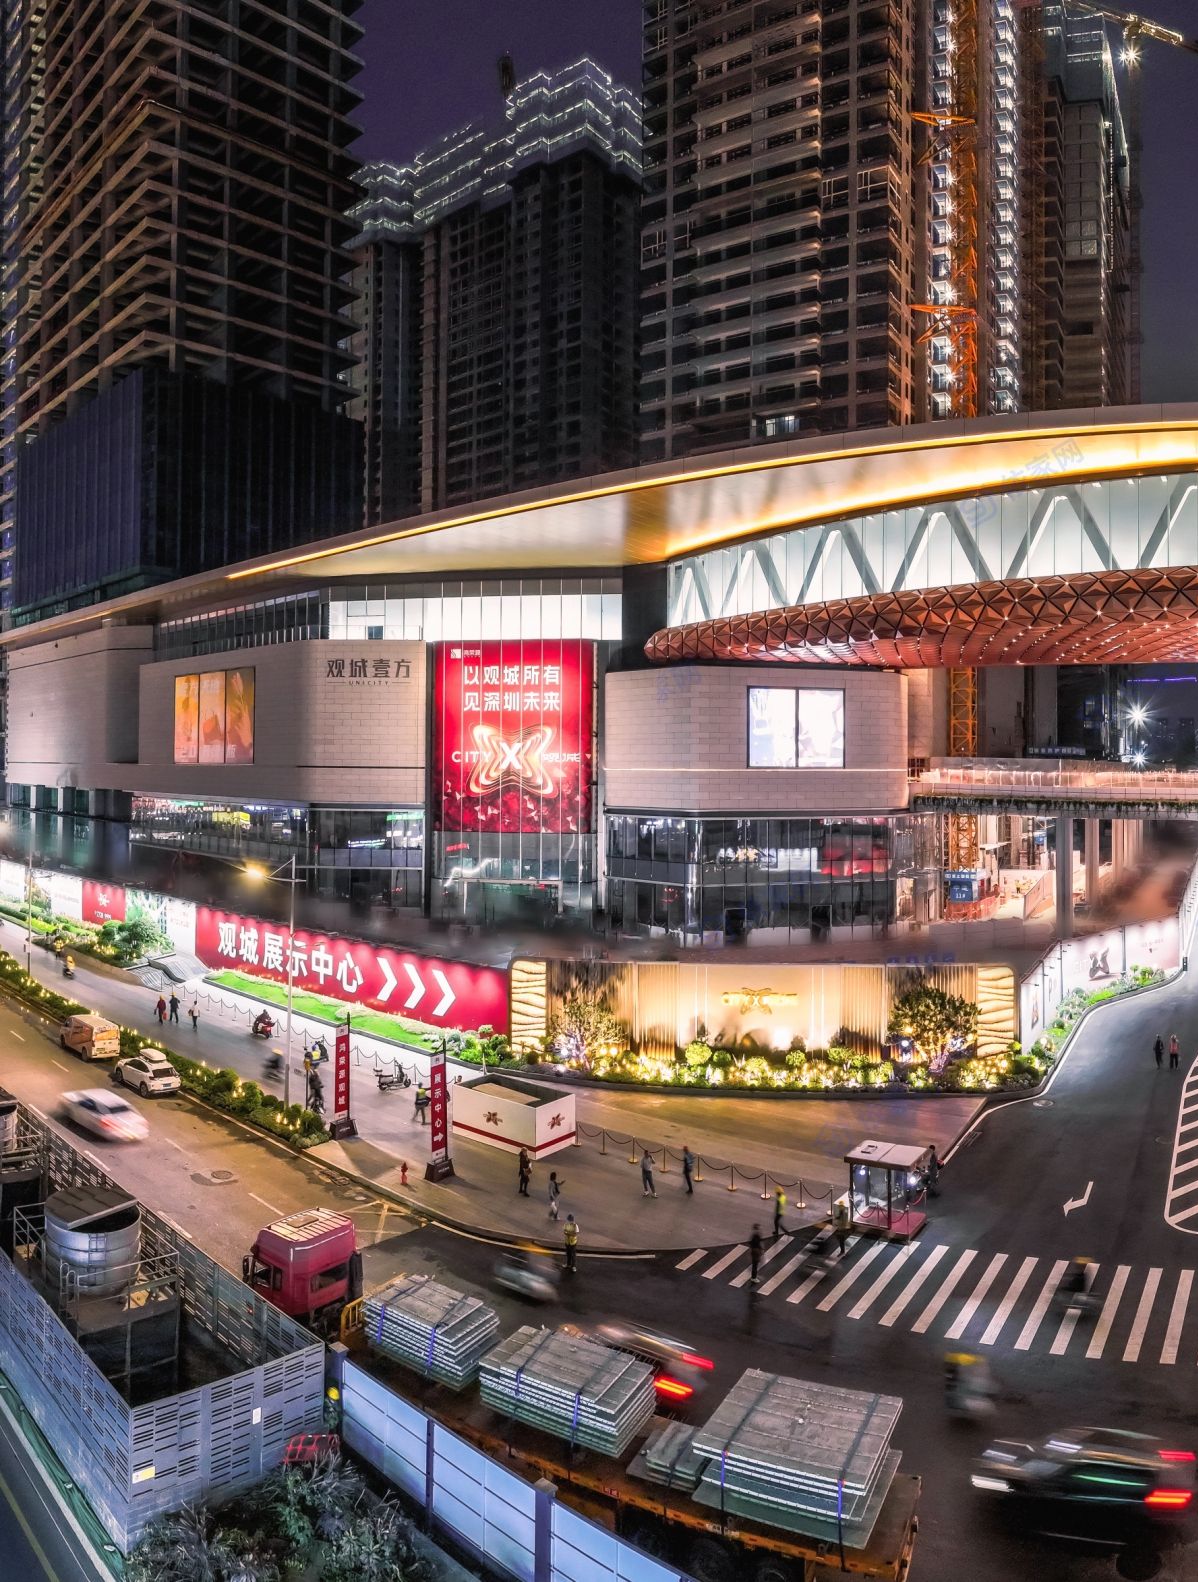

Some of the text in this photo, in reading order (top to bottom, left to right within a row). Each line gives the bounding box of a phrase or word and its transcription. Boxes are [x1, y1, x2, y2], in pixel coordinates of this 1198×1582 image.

[326, 658, 412, 678] 观城壹方
[463, 664, 561, 687] 以观城所有
[463, 691, 561, 712] 见深圳未来
[451, 750, 493, 764] CITY
[217, 921, 365, 994] 观城展示中心
[434, 1072, 443, 1128] 展示中心
